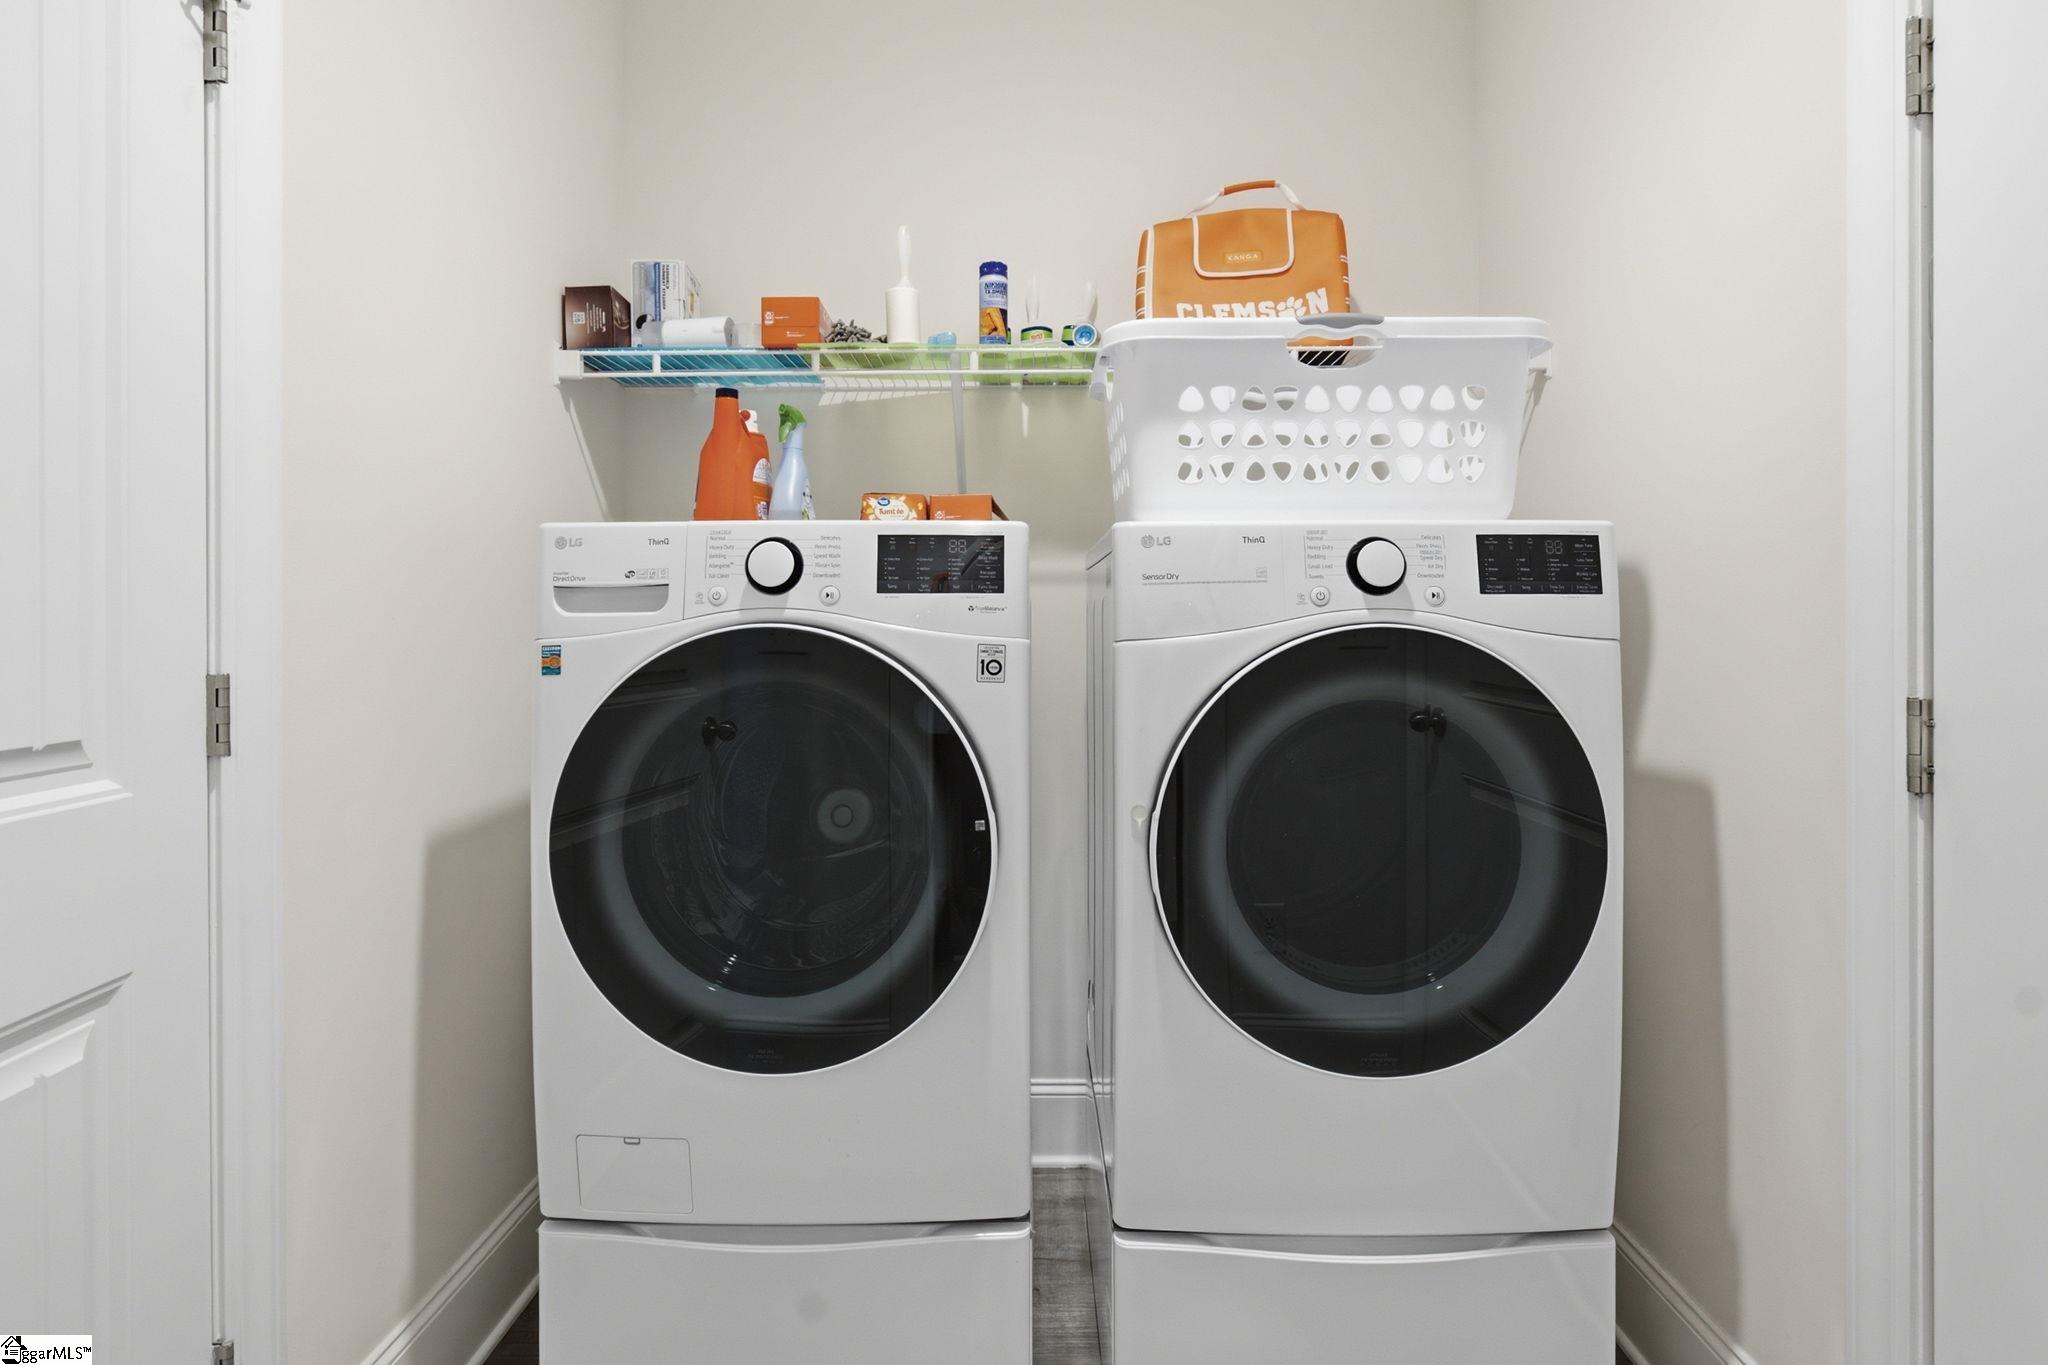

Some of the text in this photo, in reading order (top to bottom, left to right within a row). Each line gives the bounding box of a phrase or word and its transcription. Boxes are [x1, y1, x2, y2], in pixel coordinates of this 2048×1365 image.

[568, 537, 583, 548] LG
[648, 538, 670, 546] ThinQ
[1156, 536, 1172, 546] LG
[1242, 535, 1266, 544] ThinQ
[979, 658, 1003, 676] 10
